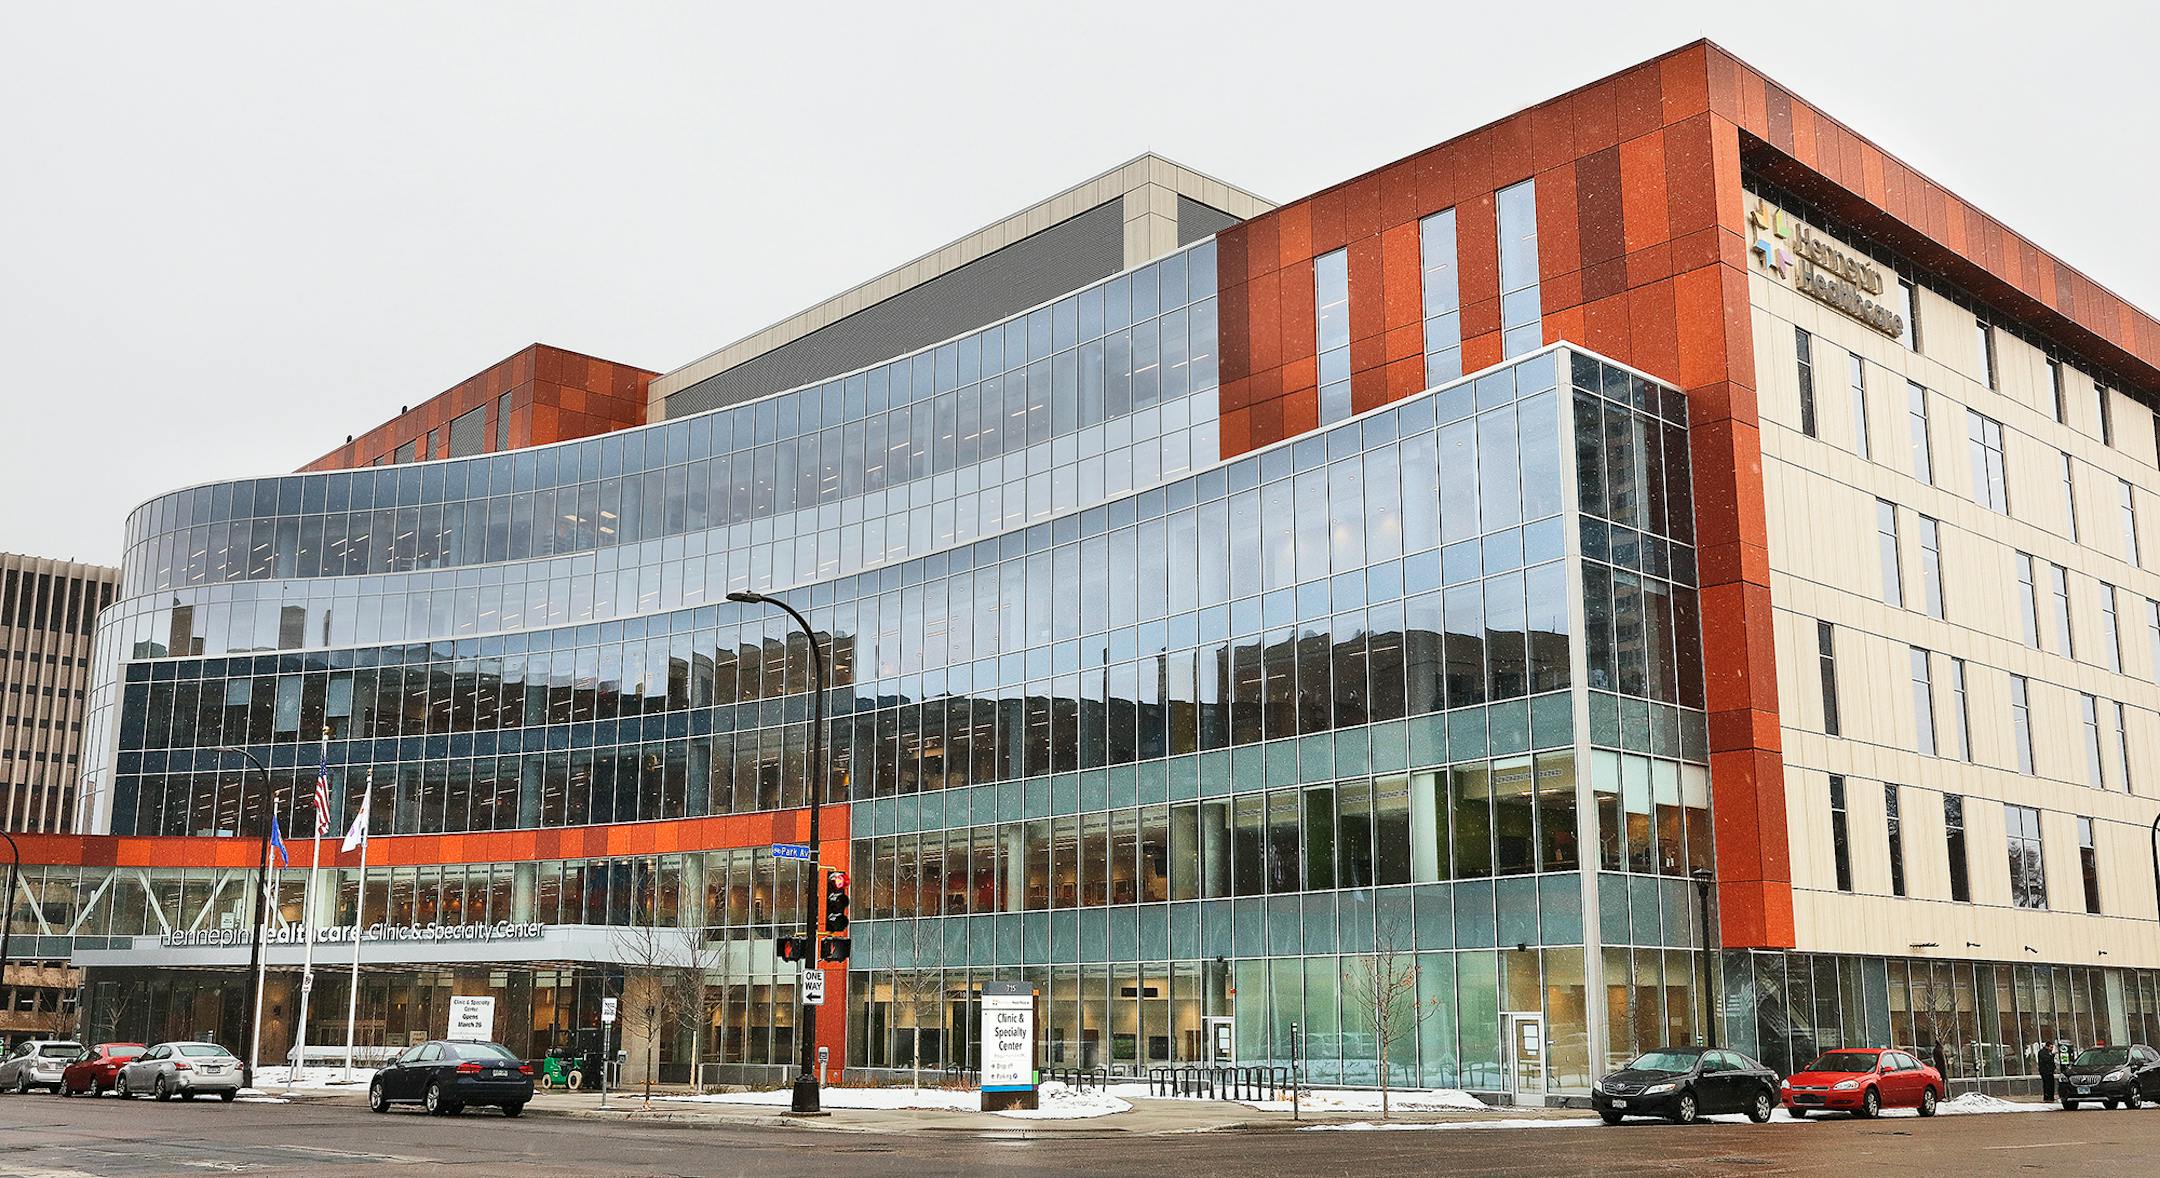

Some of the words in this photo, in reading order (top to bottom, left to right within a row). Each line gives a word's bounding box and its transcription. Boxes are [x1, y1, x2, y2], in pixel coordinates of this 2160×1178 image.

[1793, 222, 1884, 296] Hennepin
[1795, 258, 1904, 339] Healthcare
[781, 847, 798, 857] Park
[159, 925, 249, 949] Hennepin
[370, 921, 408, 941] Clinic
[411, 921, 422, 940] &
[425, 920, 495, 945] Specialty
[497, 919, 545, 939] Center
[805, 971, 822, 981] ONE
[805, 982, 822, 991] WAY
[1006, 984, 1017, 992] 715
[997, 1012, 1017, 1023] Clinic
[1018, 1012, 1025, 1023] &
[994, 1026, 1027, 1040] Specialty
[998, 1040, 1022, 1051] Center
